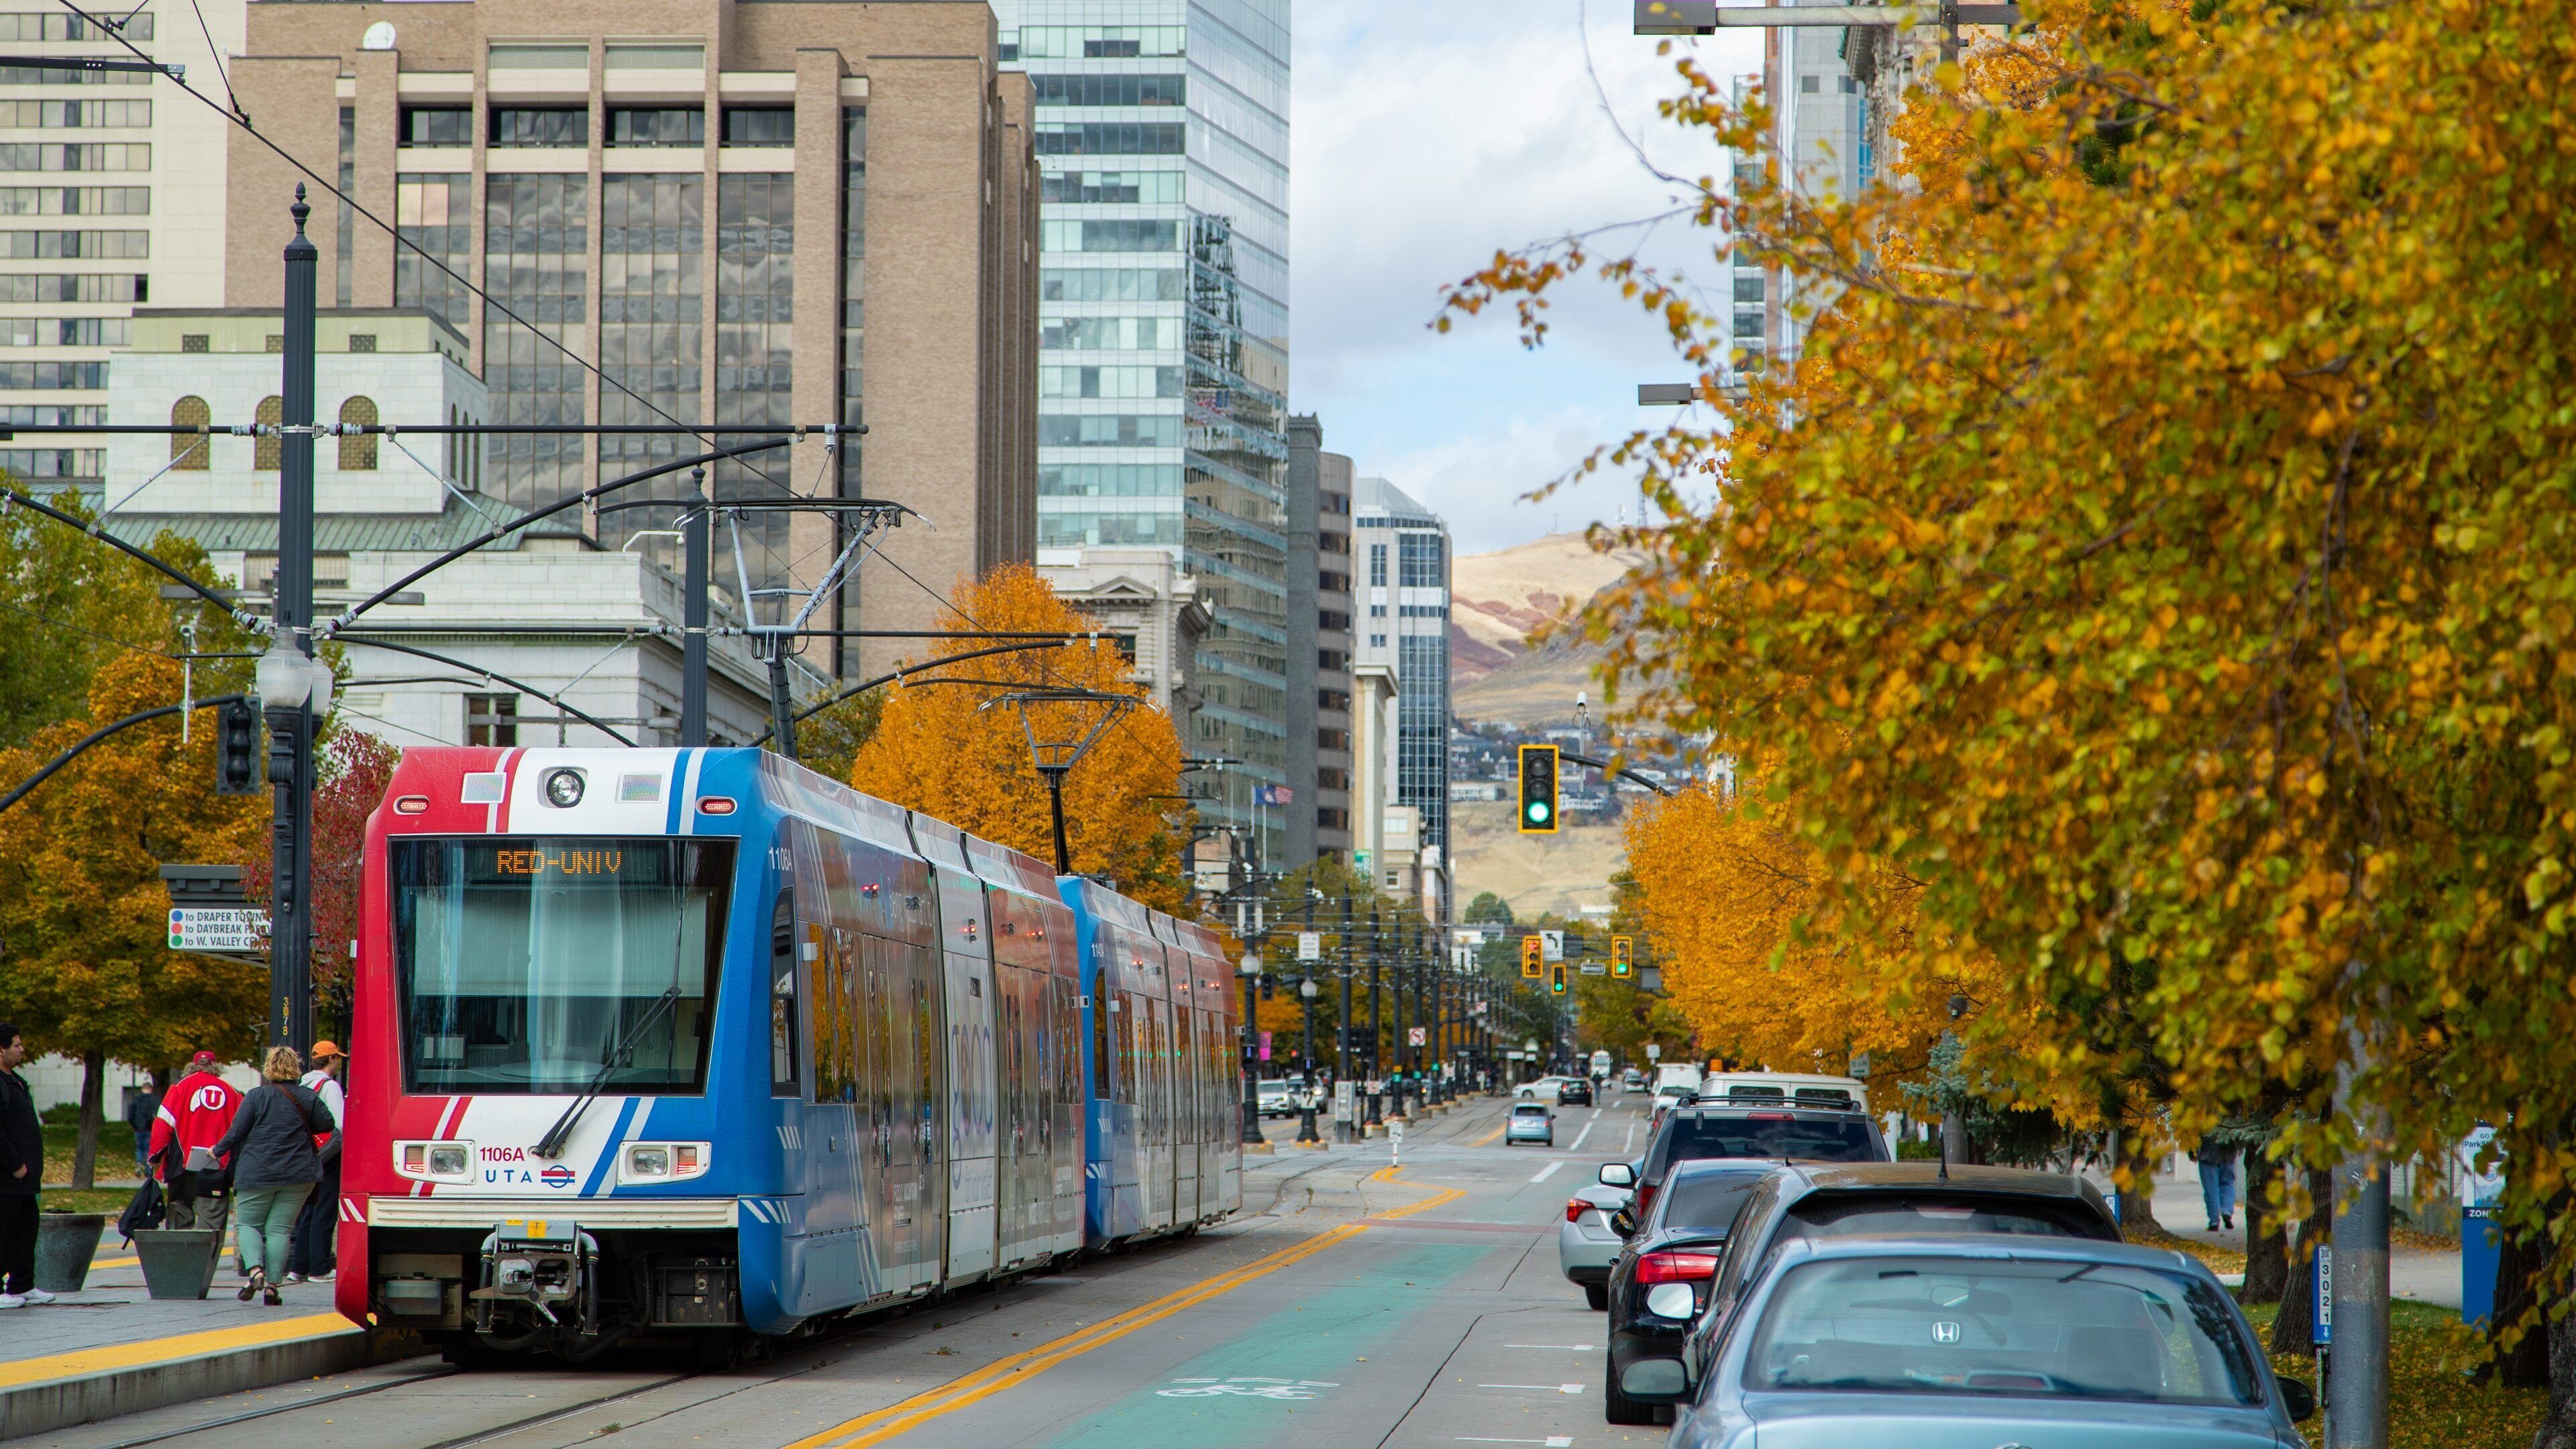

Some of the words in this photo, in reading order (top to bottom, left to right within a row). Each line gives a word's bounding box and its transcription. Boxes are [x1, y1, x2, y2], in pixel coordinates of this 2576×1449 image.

[498, 851, 621, 873] RED-UNIV
[769, 847, 793, 872] 1106A
[185, 913, 194, 921] to
[197, 912, 231, 922] DRAPER
[185, 925, 194, 933] to
[197, 924, 241, 933] DAYBREAK
[185, 937, 193, 946] to
[197, 937, 207, 946] W.
[210, 937, 240, 946] VALLEY
[205, 1089, 222, 1107] U
[480, 1147, 525, 1161] 1106A
